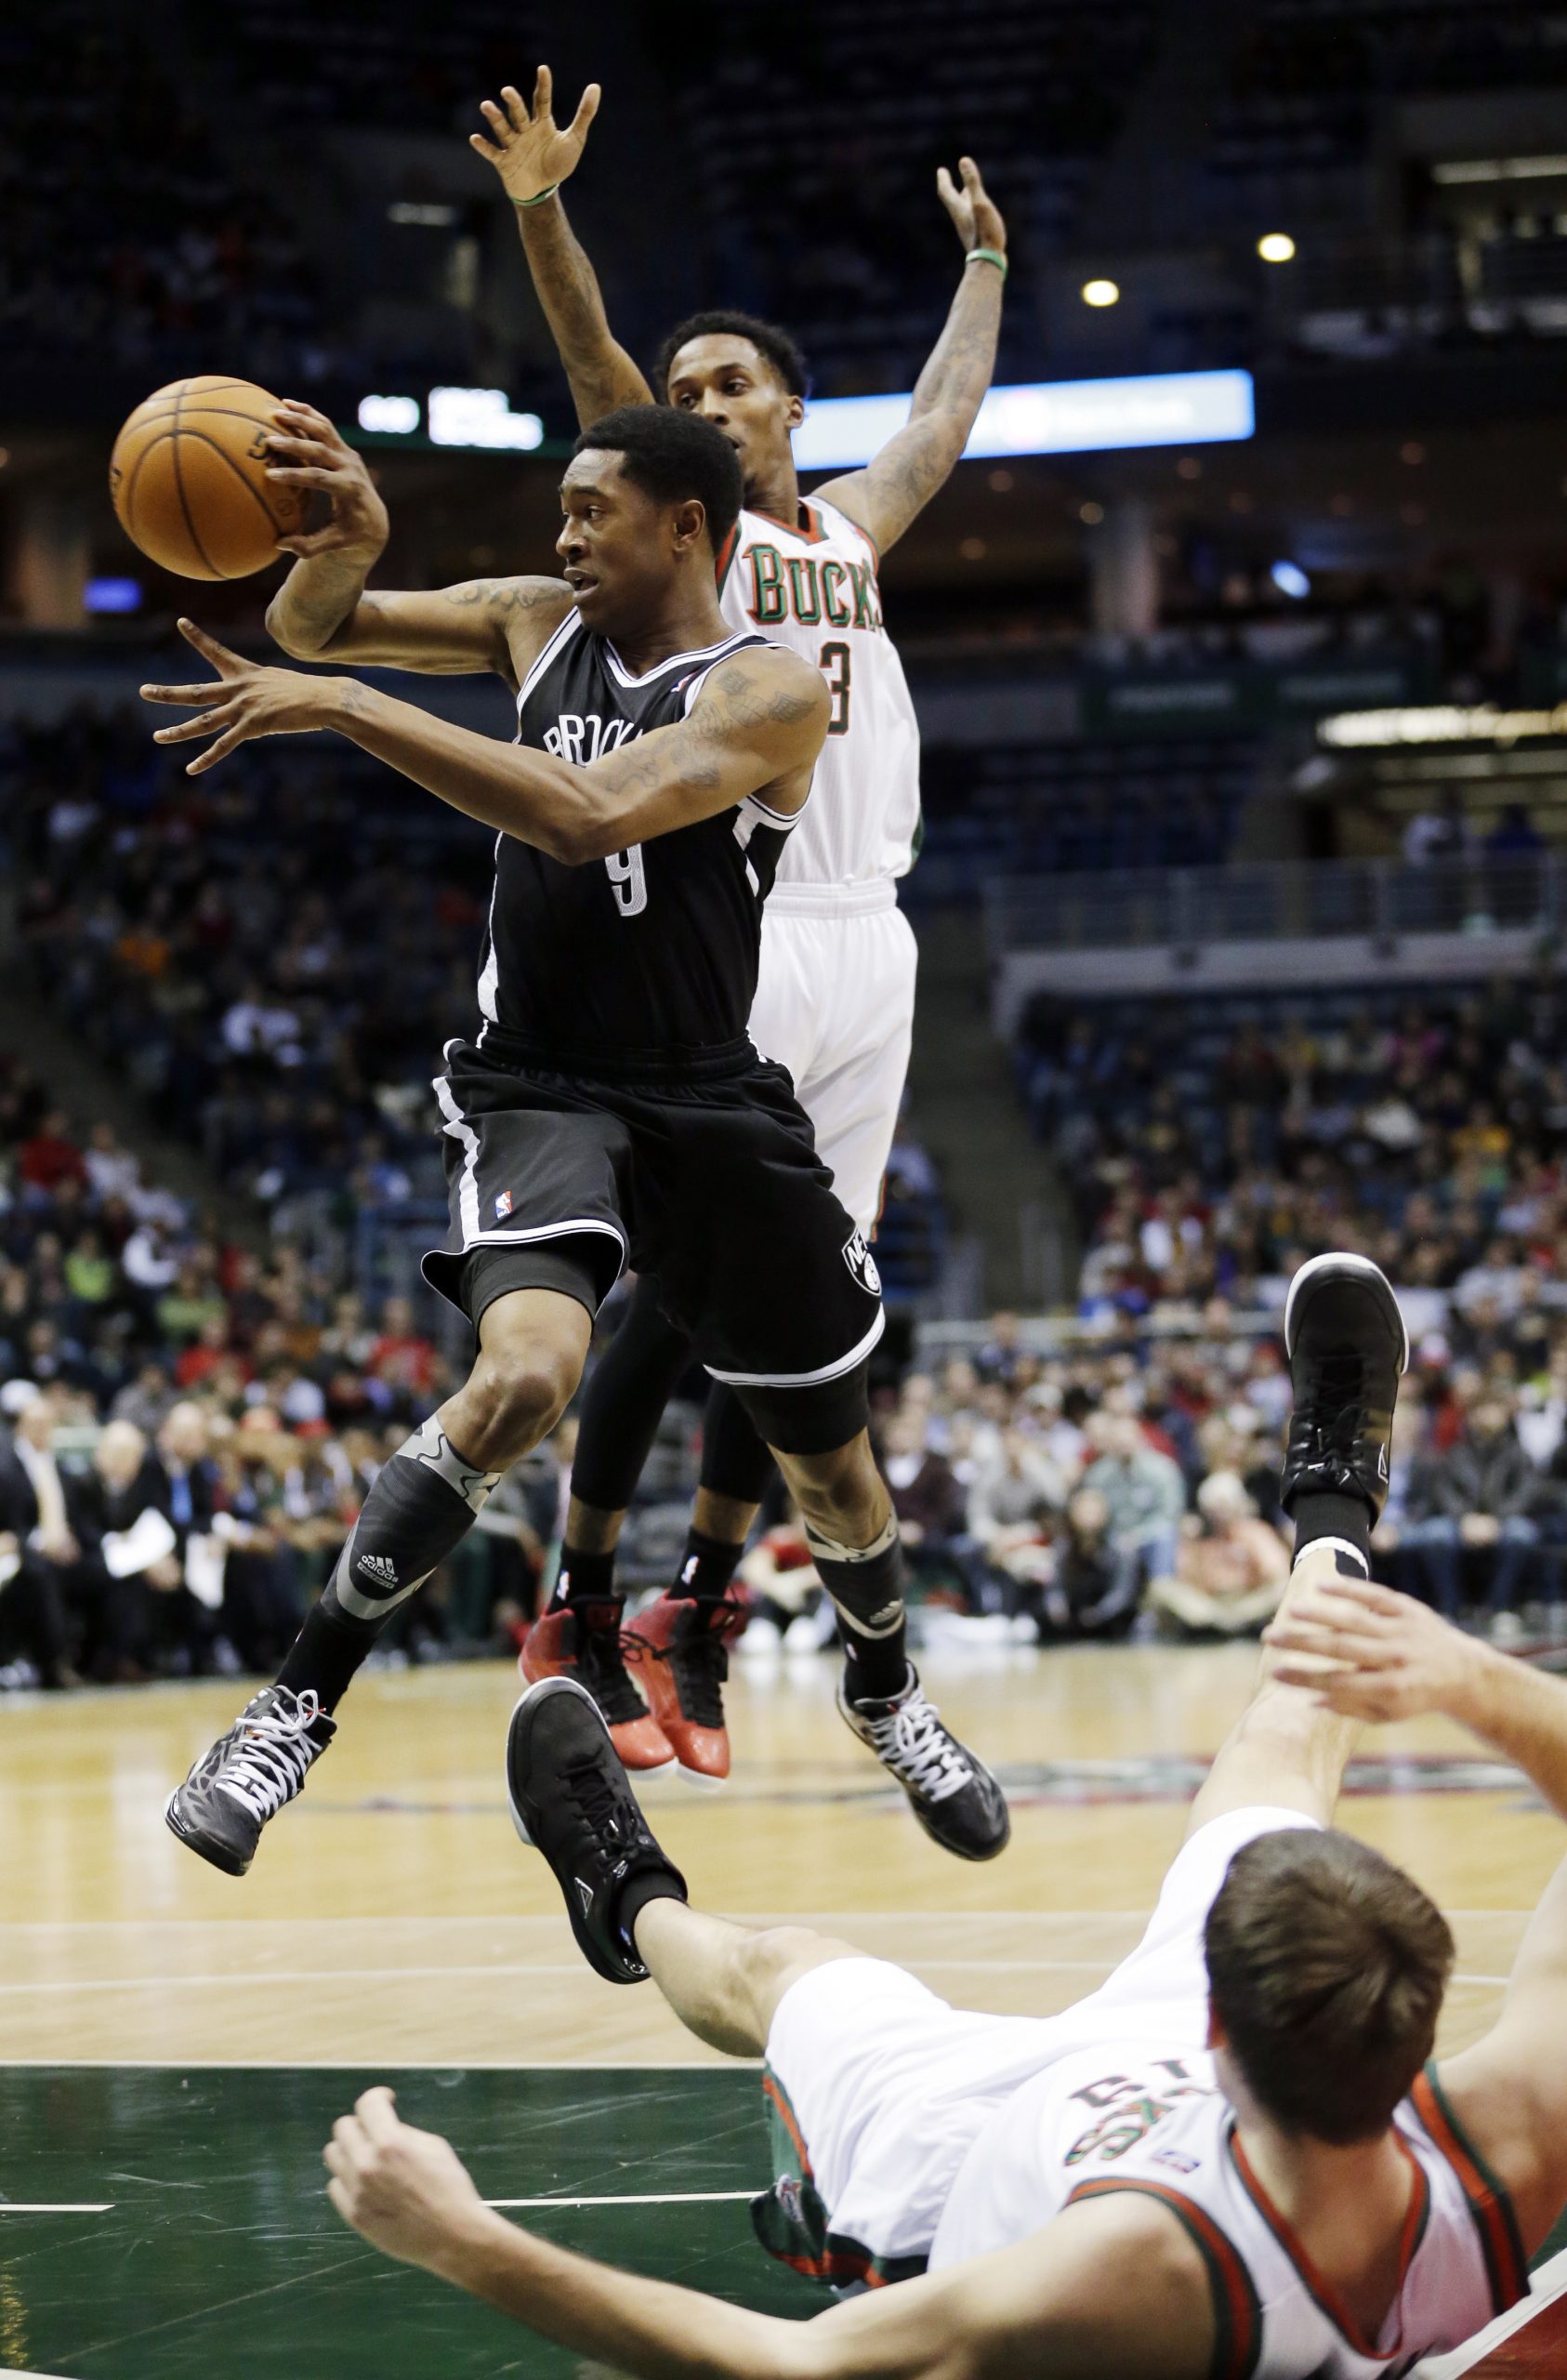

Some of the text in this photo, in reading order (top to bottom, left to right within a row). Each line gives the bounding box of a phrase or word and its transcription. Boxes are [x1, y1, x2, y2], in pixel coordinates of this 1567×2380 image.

[742, 543, 884, 633] BUCK
[819, 641, 850, 735] 3
[605, 842, 648, 917] 9
[362, 1554, 400, 1583] adidas
